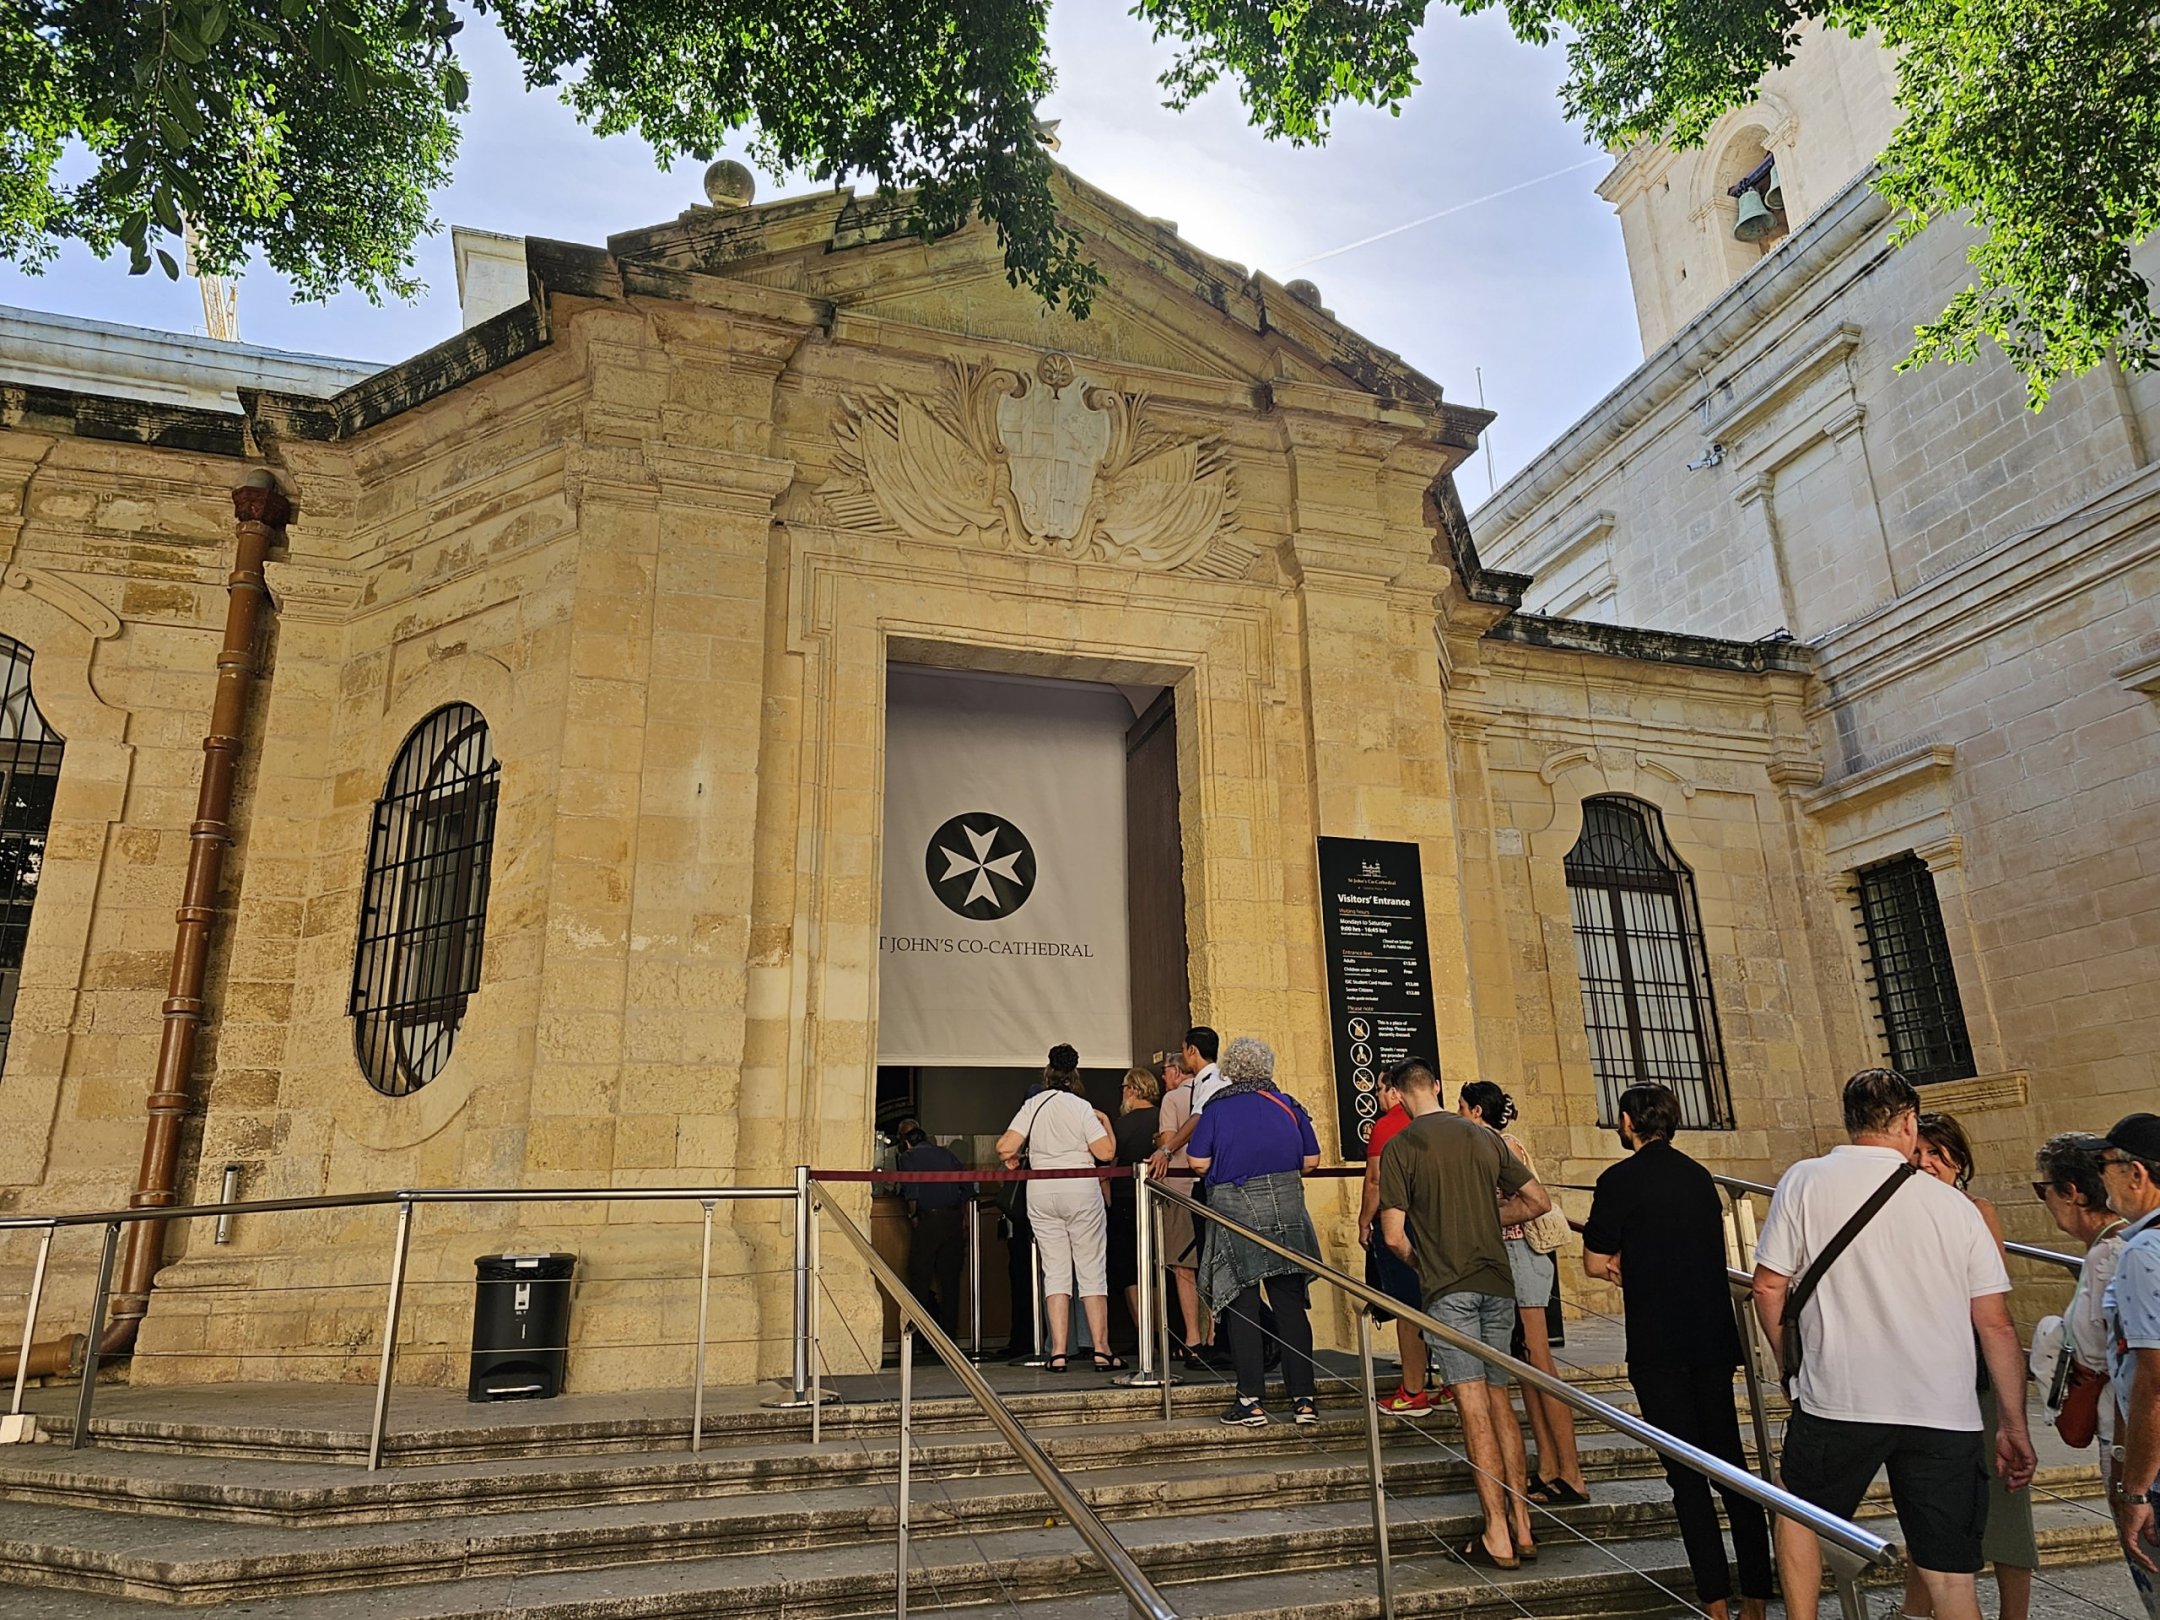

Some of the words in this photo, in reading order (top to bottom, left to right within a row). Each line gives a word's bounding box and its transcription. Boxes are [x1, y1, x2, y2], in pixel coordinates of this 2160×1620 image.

[1338, 894, 1372, 904] Visitors'
[1373, 896, 1410, 906] Entrance
[890, 937, 953, 954] JOHN'S
[958, 939, 1094, 958] CO-CATHEDRAL
